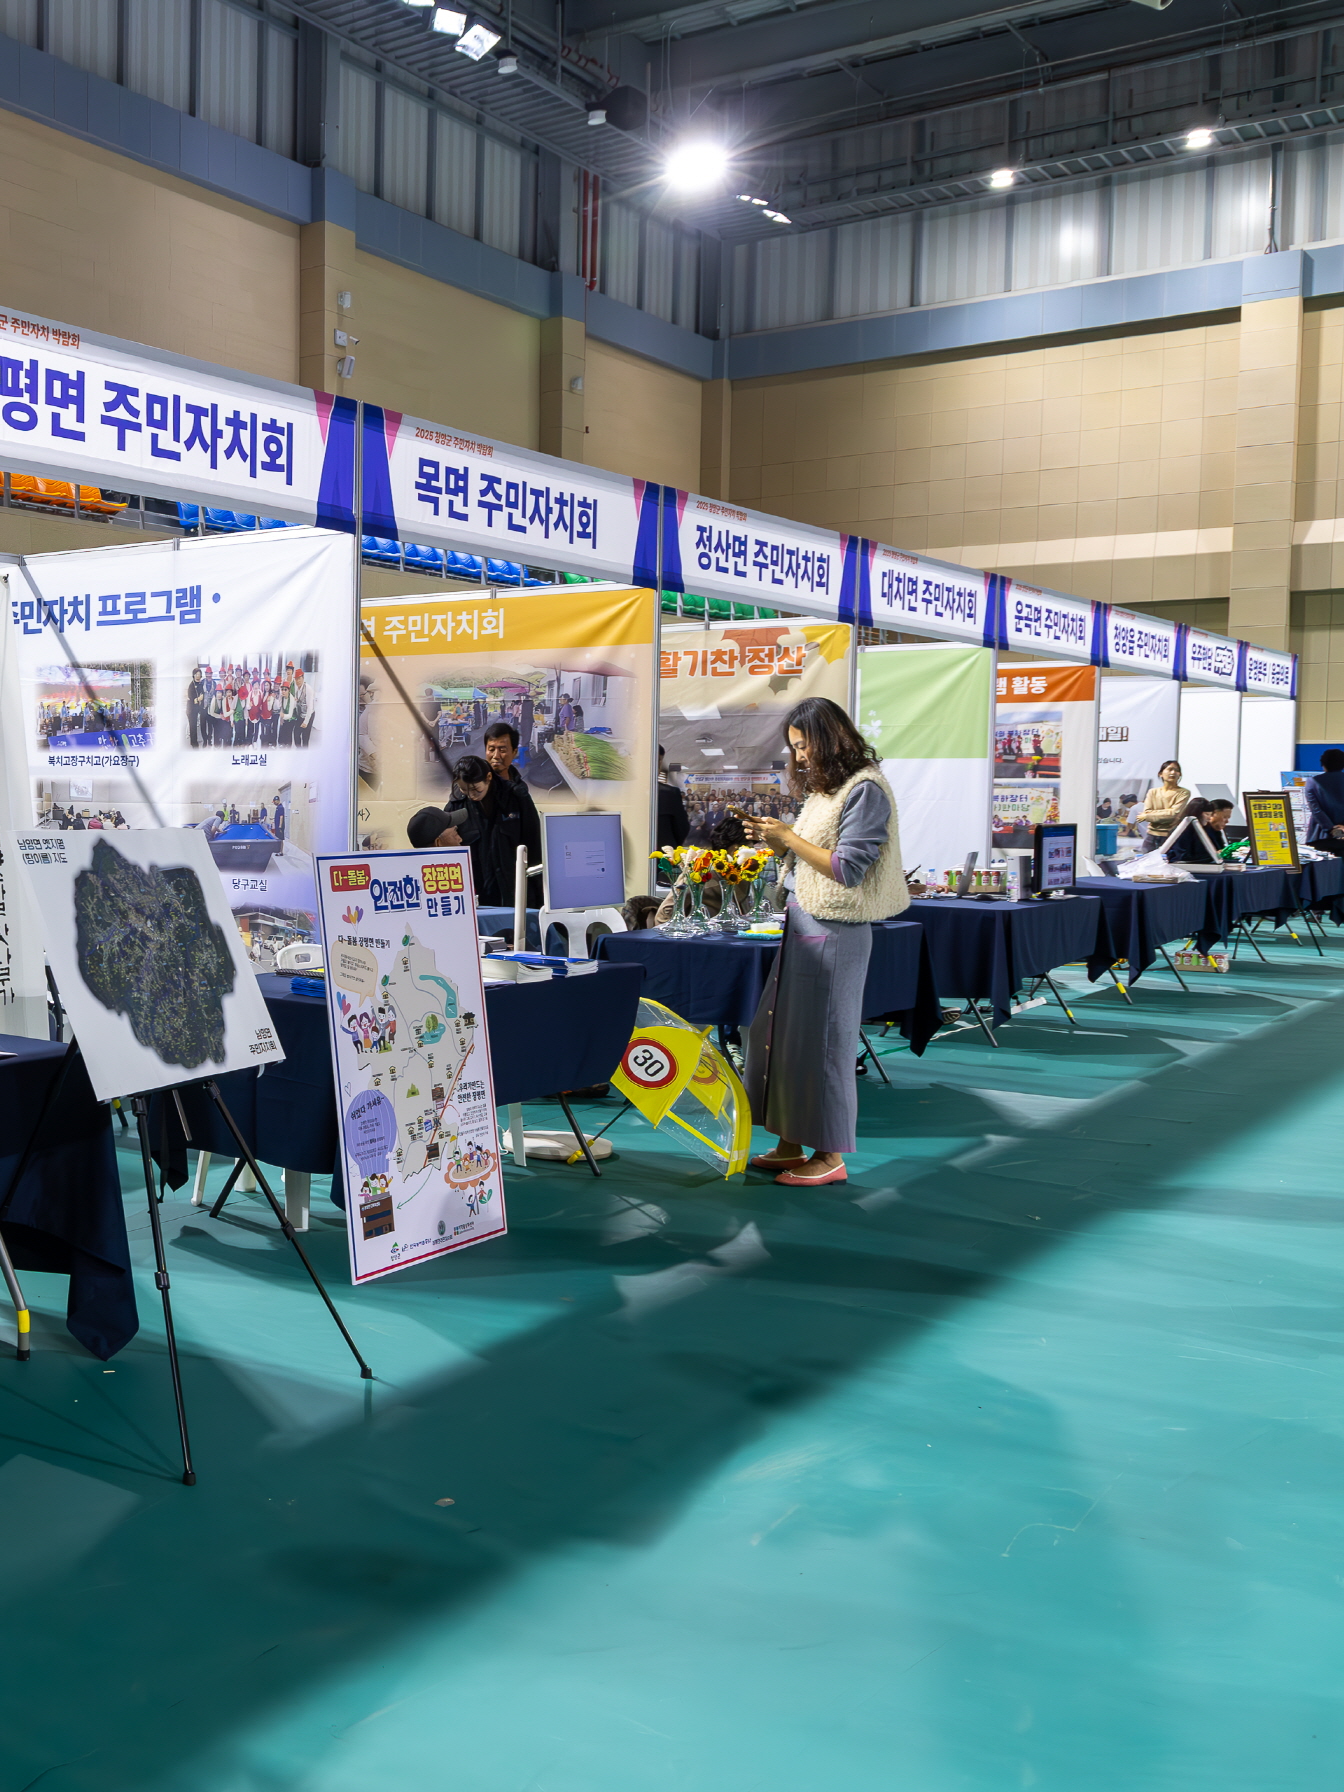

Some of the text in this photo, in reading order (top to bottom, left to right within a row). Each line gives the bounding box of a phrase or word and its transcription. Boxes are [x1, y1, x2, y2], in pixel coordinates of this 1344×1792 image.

[10, 316, 50, 342] 주민자치
[52, 326, 80, 350] 박람회
[100, 380, 294, 486] 주민자치회
[415, 427, 434, 441] 2025
[415, 457, 598, 550] 목면 주민자치회
[695, 524, 830, 595] 정산면 주민자치회
[96, 584, 202, 628] 프로그램
[881, 569, 977, 625] 대치면 주민자치회
[383, 608, 505, 644] 주민자치회
[1014, 600, 1086, 646] 운곡면 주민자치회
[660, 645, 806, 679] 활기찬 정산
[1137, 630, 1170, 663] 주민자치회
[1012, 676, 1048, 694] 활동
[231, 753, 267, 767] 노래교실
[17, 838, 42, 850] 남양면
[231, 877, 268, 892] 당구교실
[370, 875, 421, 914] 안전한
[422, 864, 464, 893] 장평면
[427, 895, 465, 917] 만들기
[632, 1048, 665, 1078] 30
